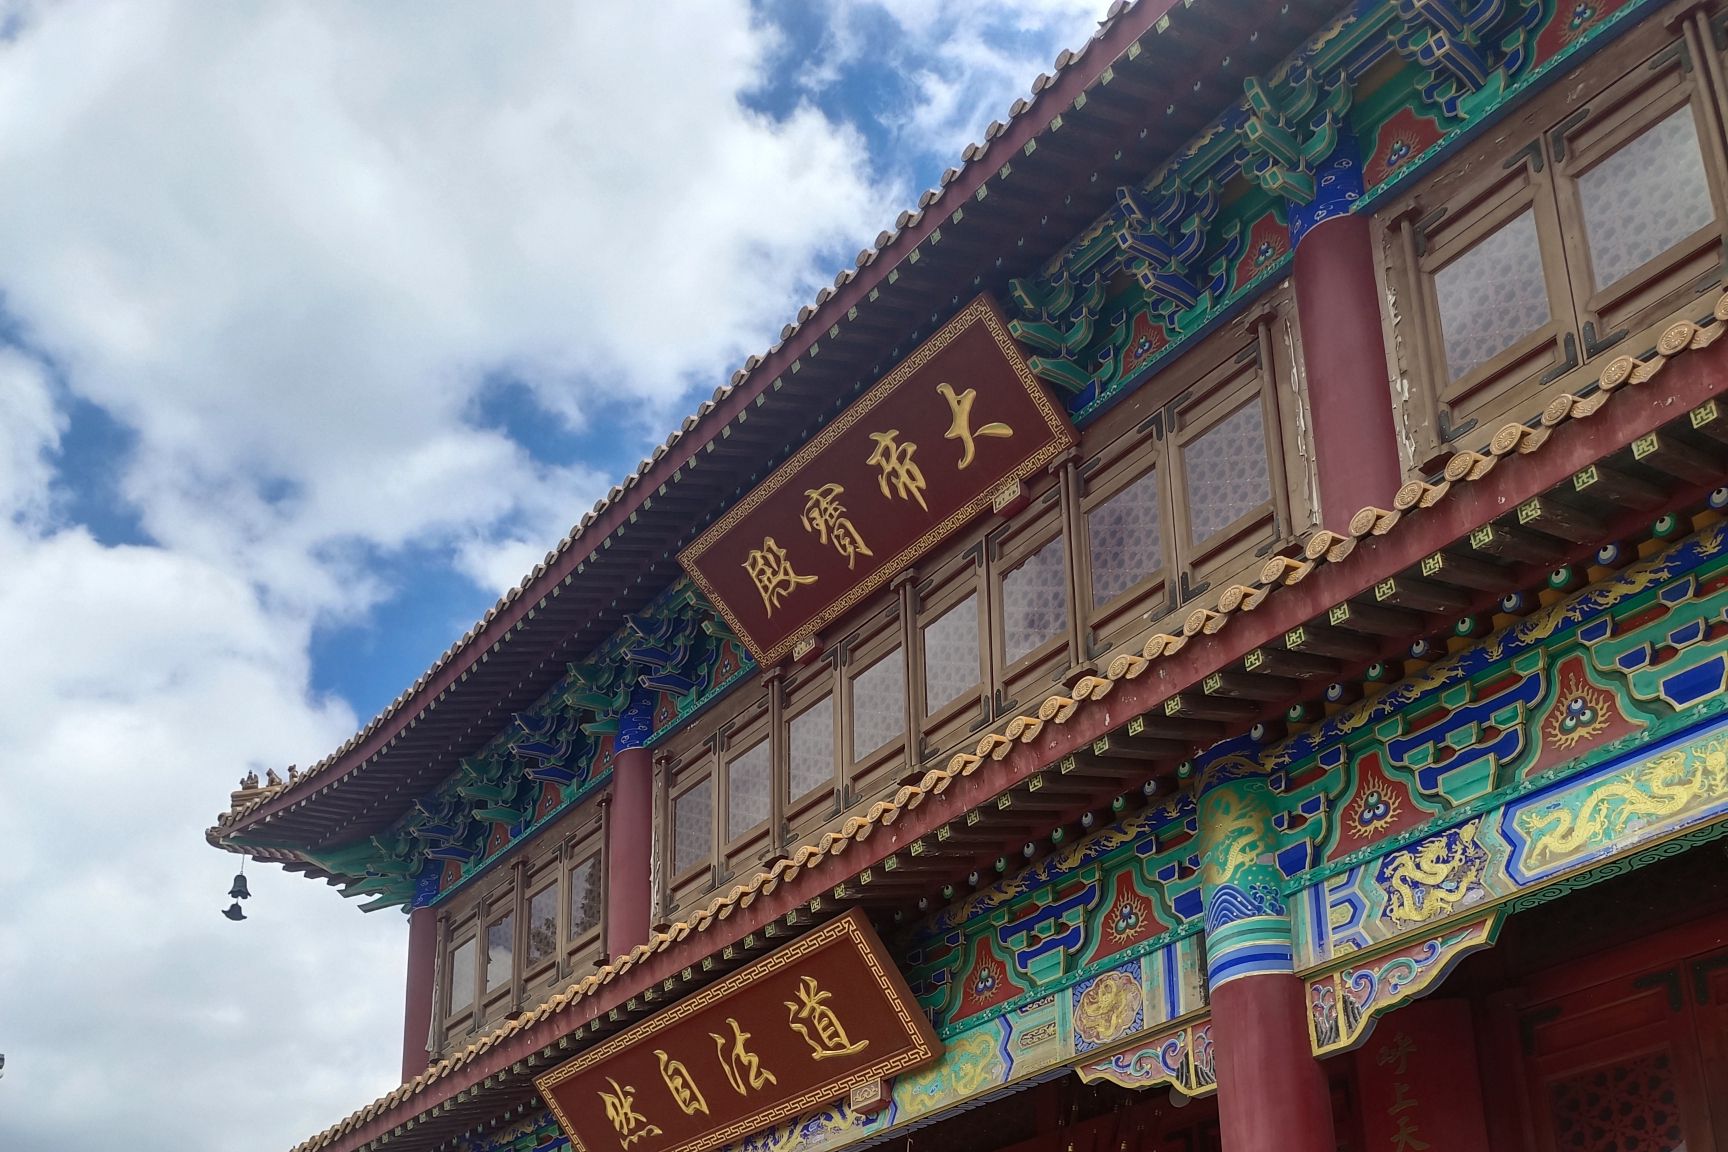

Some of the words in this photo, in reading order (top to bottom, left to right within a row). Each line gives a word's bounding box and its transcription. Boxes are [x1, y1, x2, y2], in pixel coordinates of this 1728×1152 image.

[742, 382, 1014, 619] 大帝寶殿
[597, 975, 870, 1151] 道法自然
